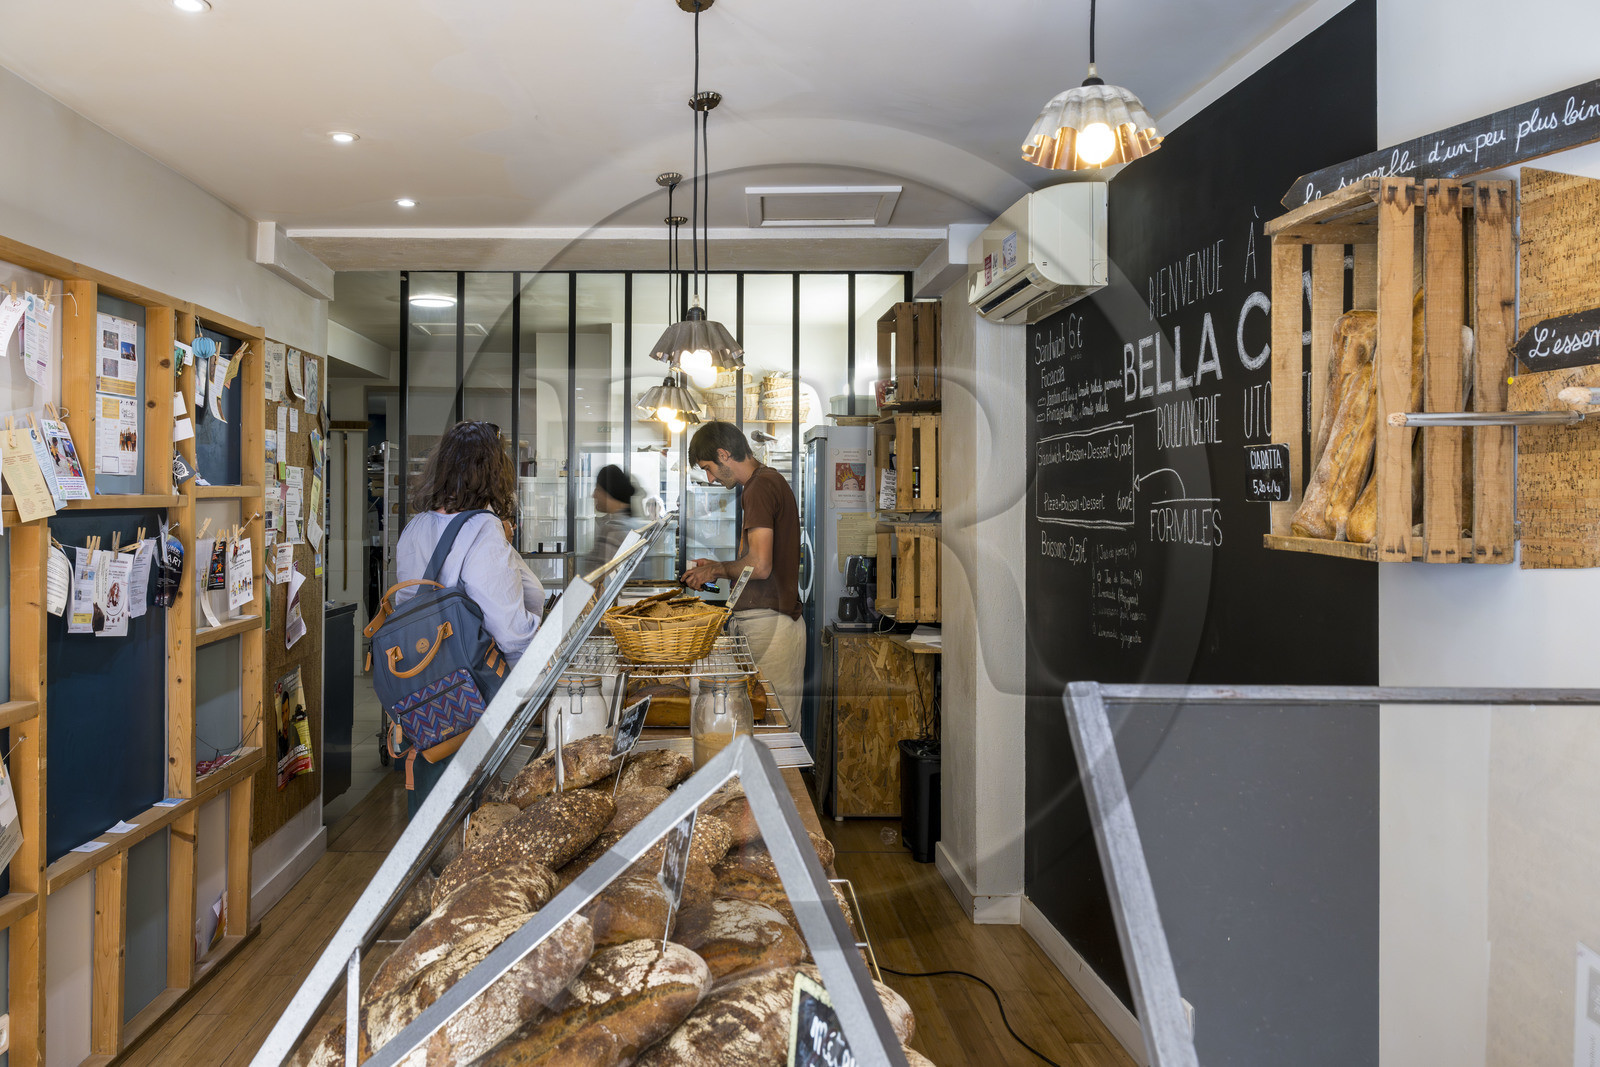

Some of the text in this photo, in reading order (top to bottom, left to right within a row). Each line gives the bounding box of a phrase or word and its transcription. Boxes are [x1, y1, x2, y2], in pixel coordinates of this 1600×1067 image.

[1428, 140, 1472, 164] d'un
[1474, 130, 1506, 163] peu
[1515, 107, 1558, 153] plus
[1149, 206, 1260, 322] BIENVENUE À
[1124, 312, 1224, 403] BELLA
[1156, 393, 1223, 450] BOULANGERIE
[1250, 448, 1283, 470] CIABATTA
[1041, 530, 1067, 560] Boissons
[1150, 507, 1223, 547] FORMULES
